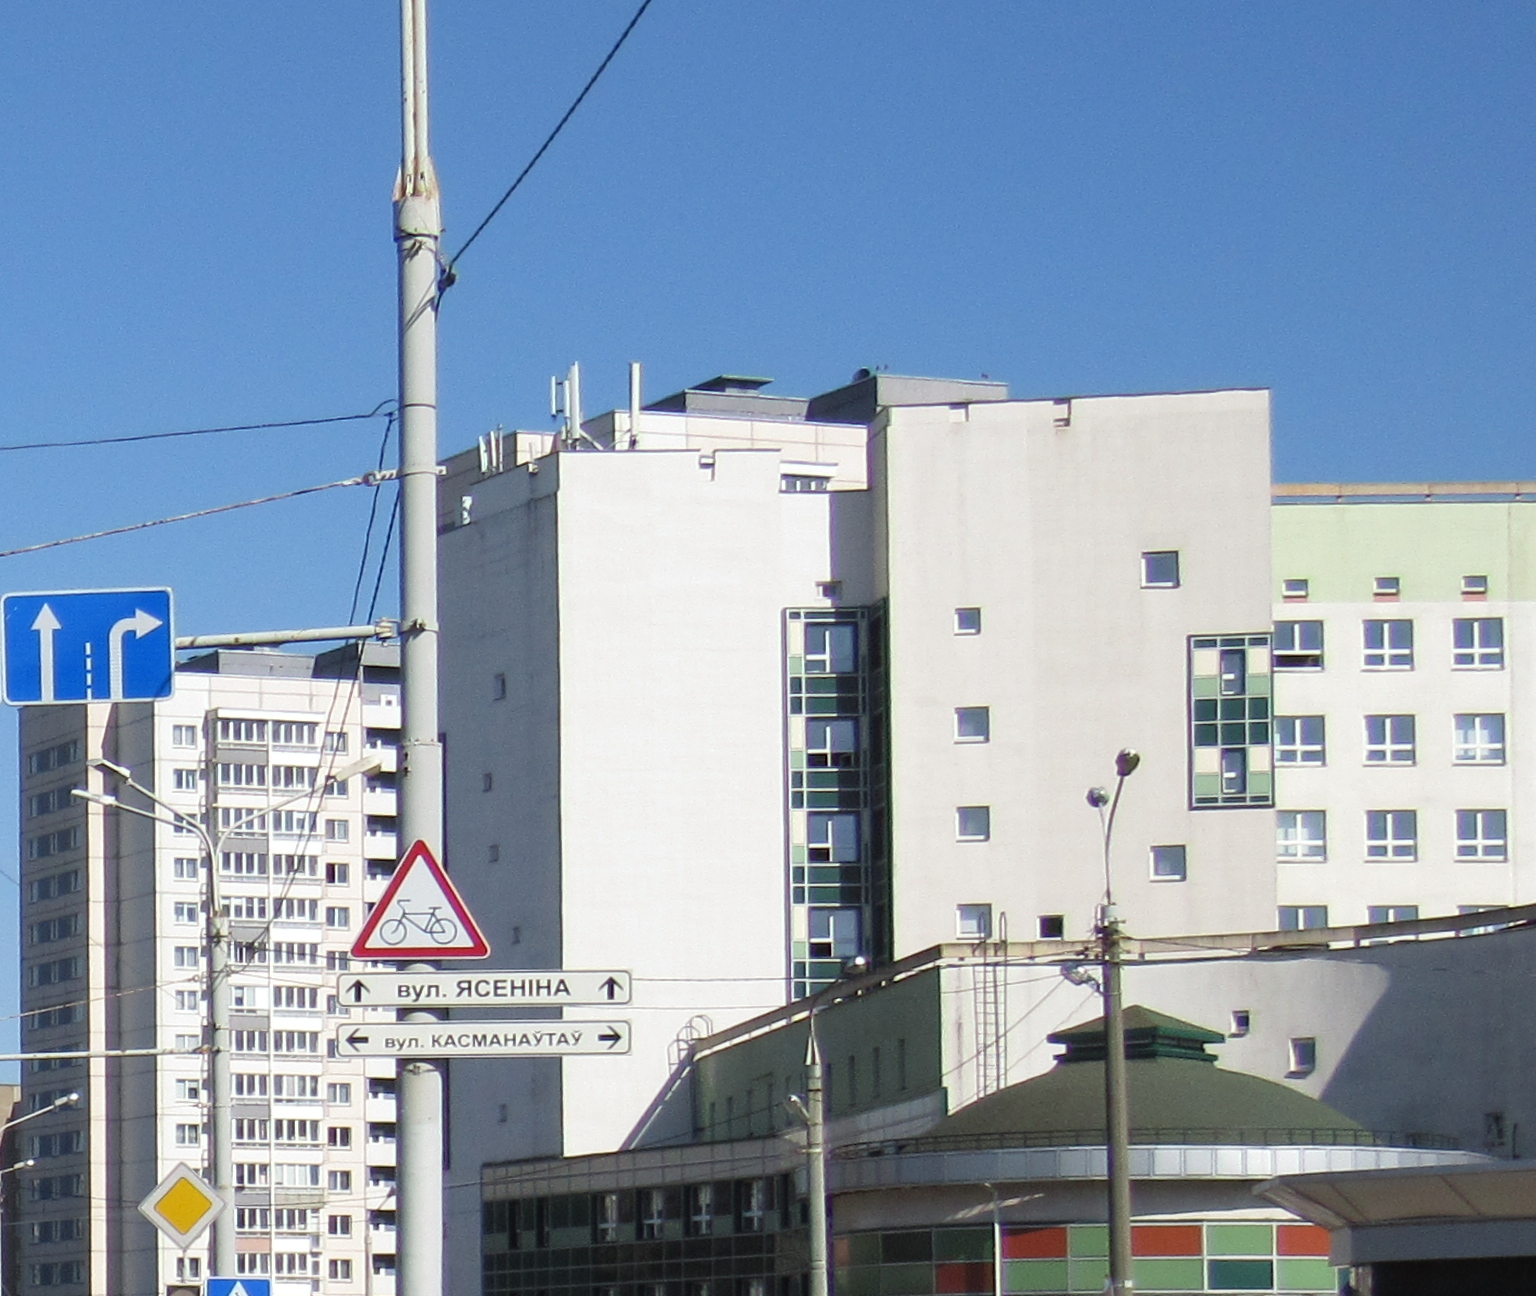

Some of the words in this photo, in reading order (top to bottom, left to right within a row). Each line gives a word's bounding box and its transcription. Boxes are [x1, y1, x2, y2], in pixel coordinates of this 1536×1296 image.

[396, 985, 448, 1003] вул.
[455, 979, 572, 998] ЯСЕНІНА
[384, 1036, 425, 1051] вул.
[431, 1029, 583, 1048] КАСМАНАЎТАЎ
